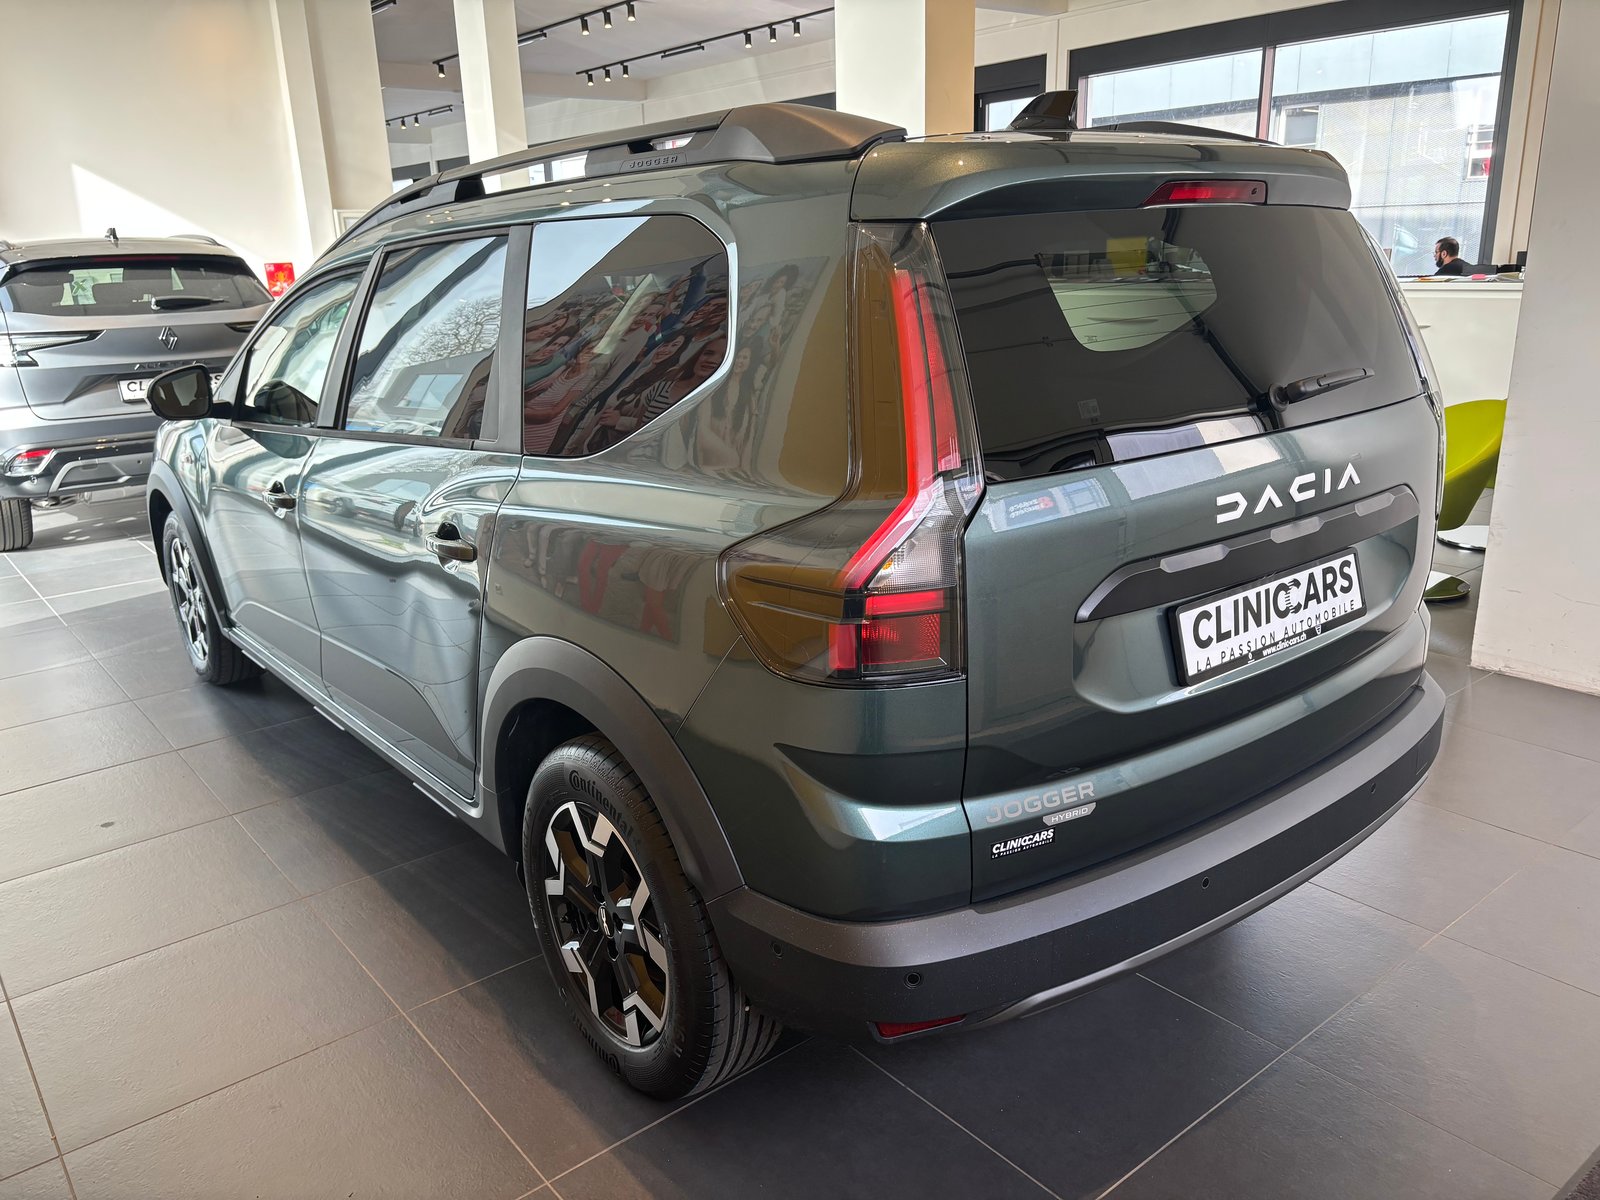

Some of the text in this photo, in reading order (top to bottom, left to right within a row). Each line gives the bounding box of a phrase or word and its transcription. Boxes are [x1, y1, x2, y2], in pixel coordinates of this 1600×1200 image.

[629, 155, 679, 169] JOGGER
[1216, 462, 1361, 524] DACIA
[1196, 599, 1355, 673] LA PASSION AUTOMOBILE
[1262, 632, 1307, 657] www.clinic-cars.ch
[569, 769, 635, 839] Continental
[985, 781, 1096, 823] JOGGER
[1051, 807, 1089, 823] HYBRID
